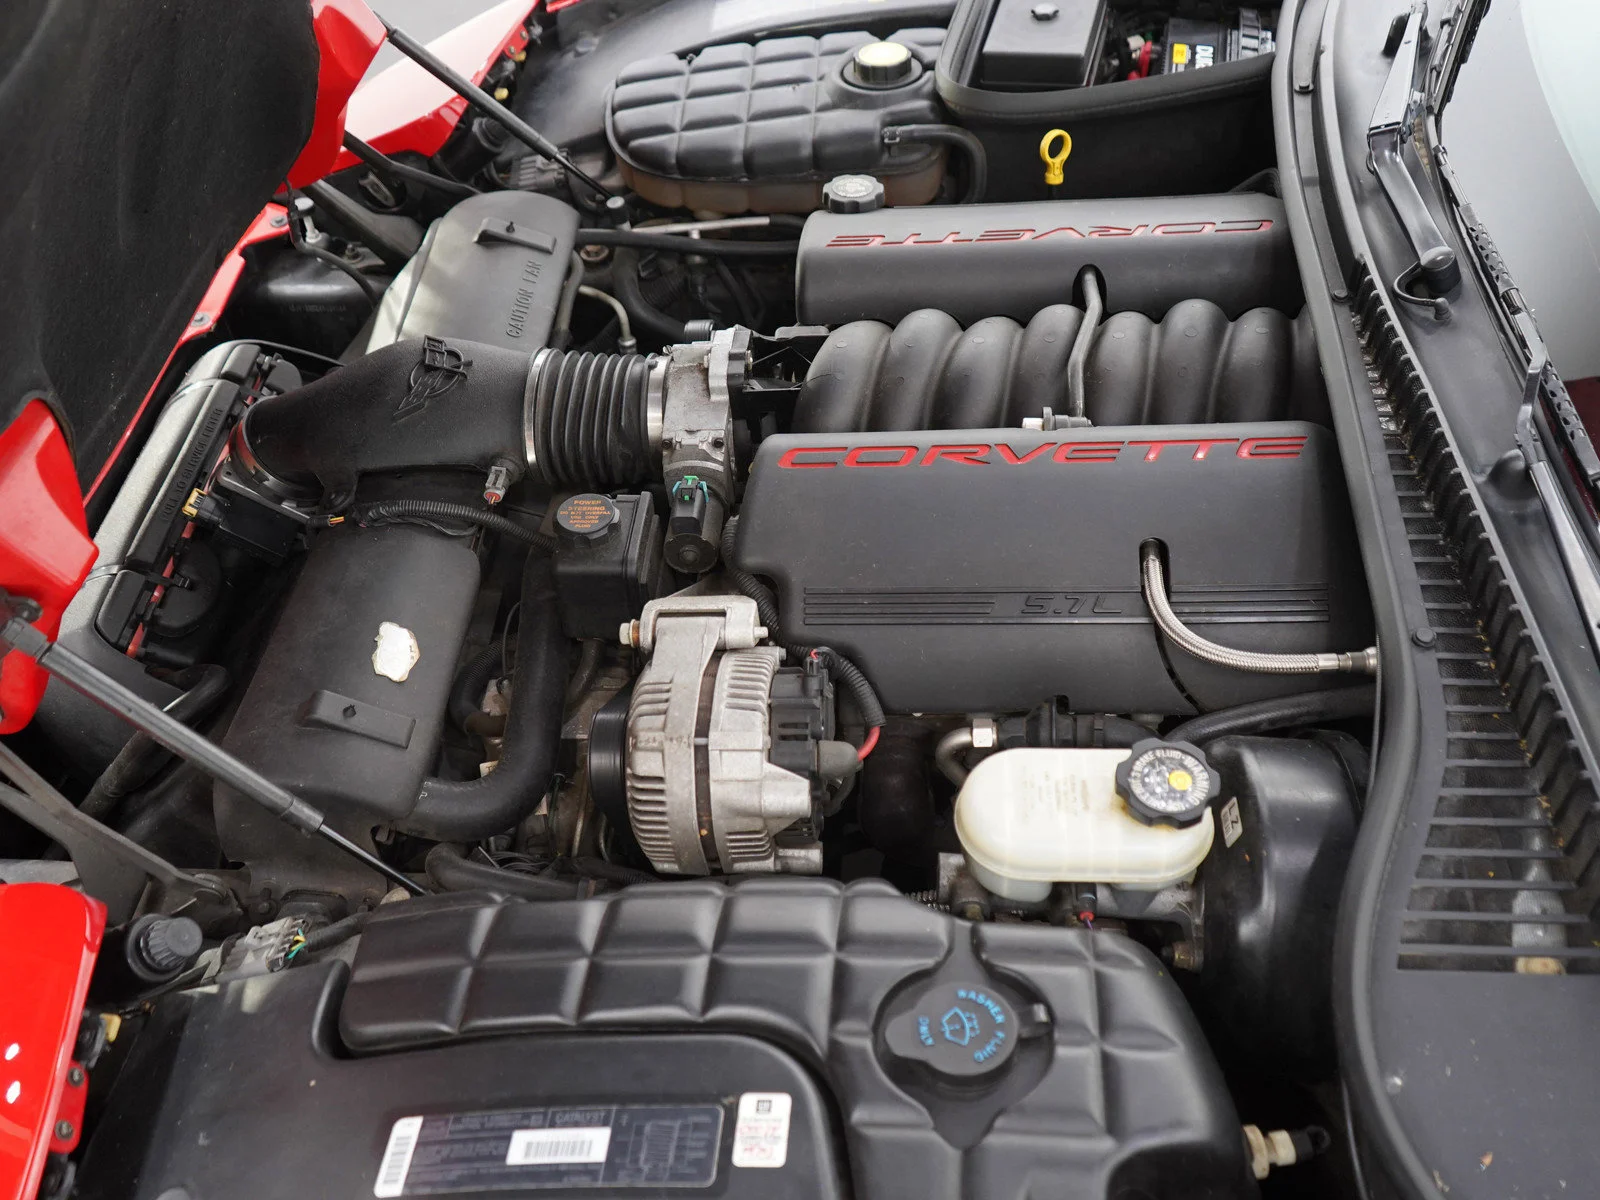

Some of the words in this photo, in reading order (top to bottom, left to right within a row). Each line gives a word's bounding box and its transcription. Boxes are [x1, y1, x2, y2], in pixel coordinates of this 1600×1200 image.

[825, 219, 1274, 248] CORVETTE
[506, 288, 534, 338] CAUTION
[776, 436, 1309, 470] CORVETTE
[1020, 595, 1123, 614] 5.7L
[1132, 750, 1156, 771] BRAKE
[1154, 748, 1182, 760] FLUID
[956, 989, 1005, 1024] WASHER
[918, 1016, 936, 1047] ONLY
[973, 1030, 1006, 1063] FLUID
[555, 1111, 606, 1123] CATALYST
